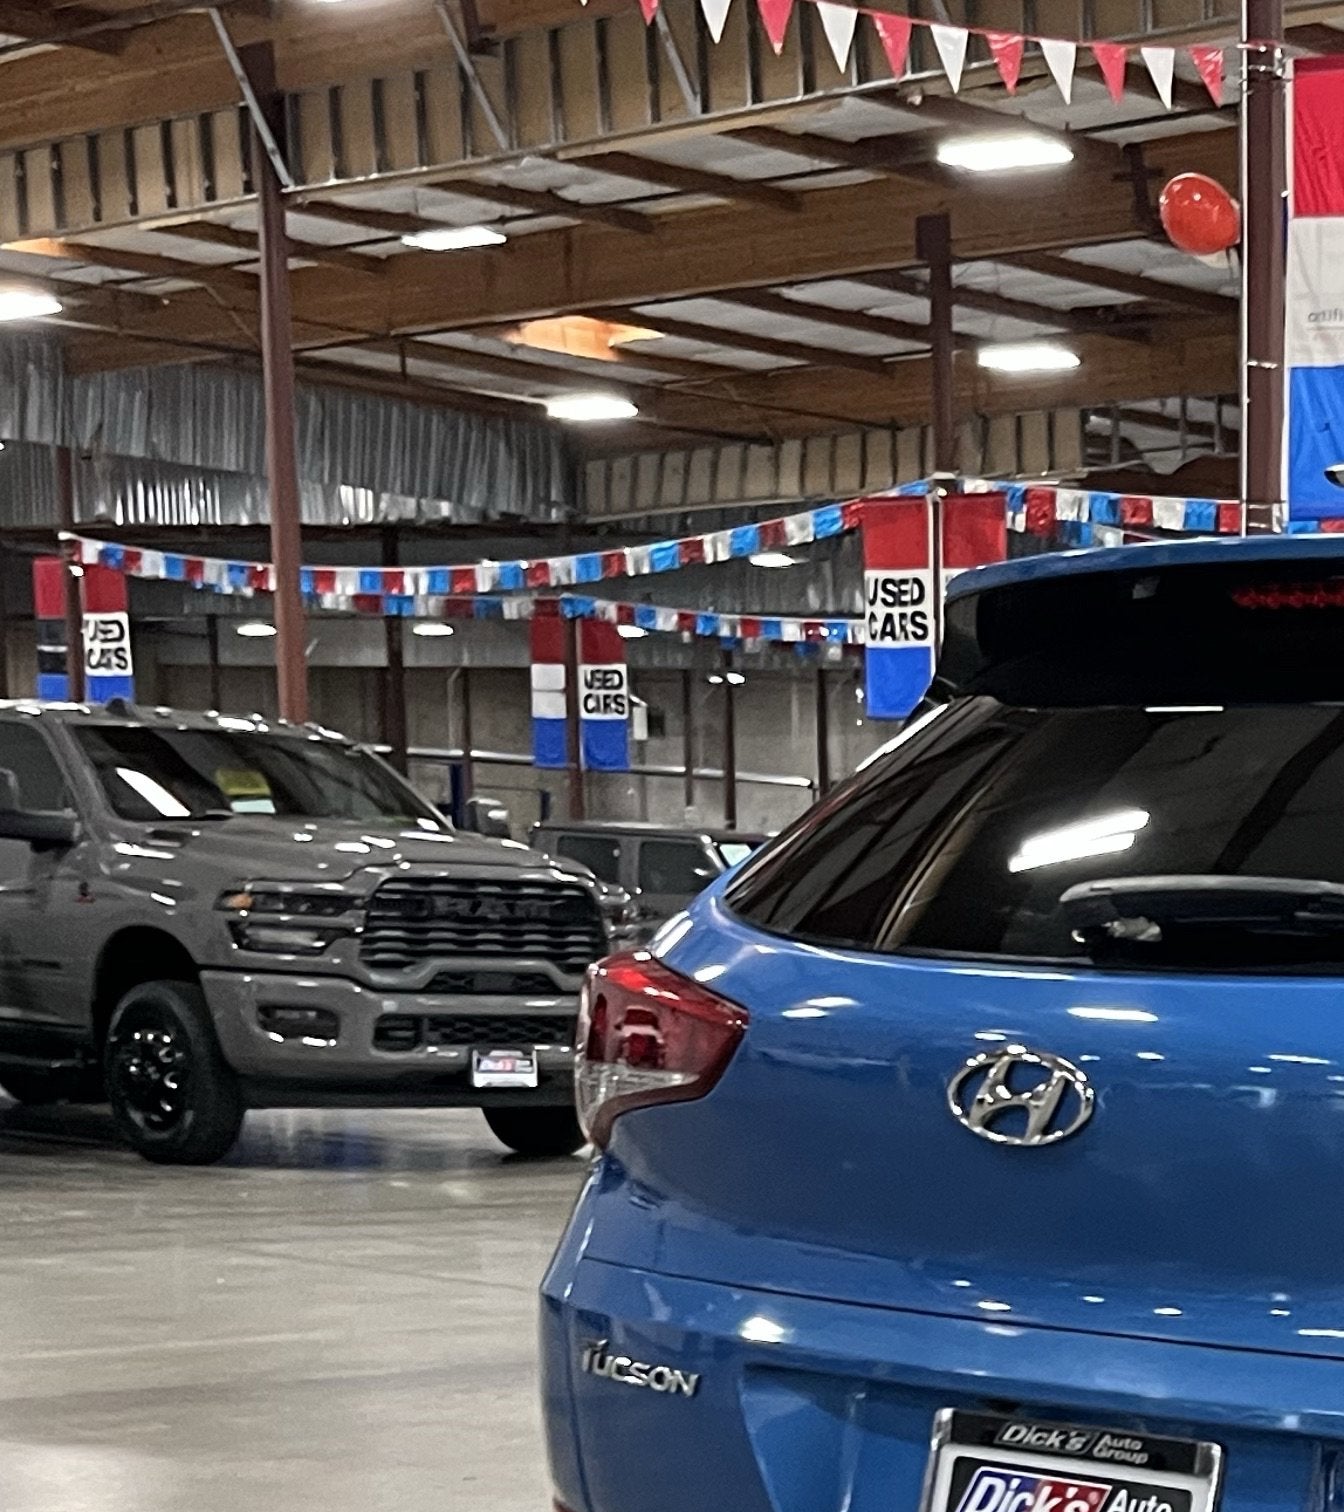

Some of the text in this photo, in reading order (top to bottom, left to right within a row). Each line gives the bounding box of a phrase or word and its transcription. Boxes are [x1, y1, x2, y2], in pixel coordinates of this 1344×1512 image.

[865, 576, 925, 607] USED
[869, 610, 928, 641] CARS
[581, 1338, 700, 1397] TUCSON
[1001, 1424, 1087, 1452] Dick's
[1095, 1433, 1143, 1451] Auto
[1093, 1447, 1149, 1465] Group
